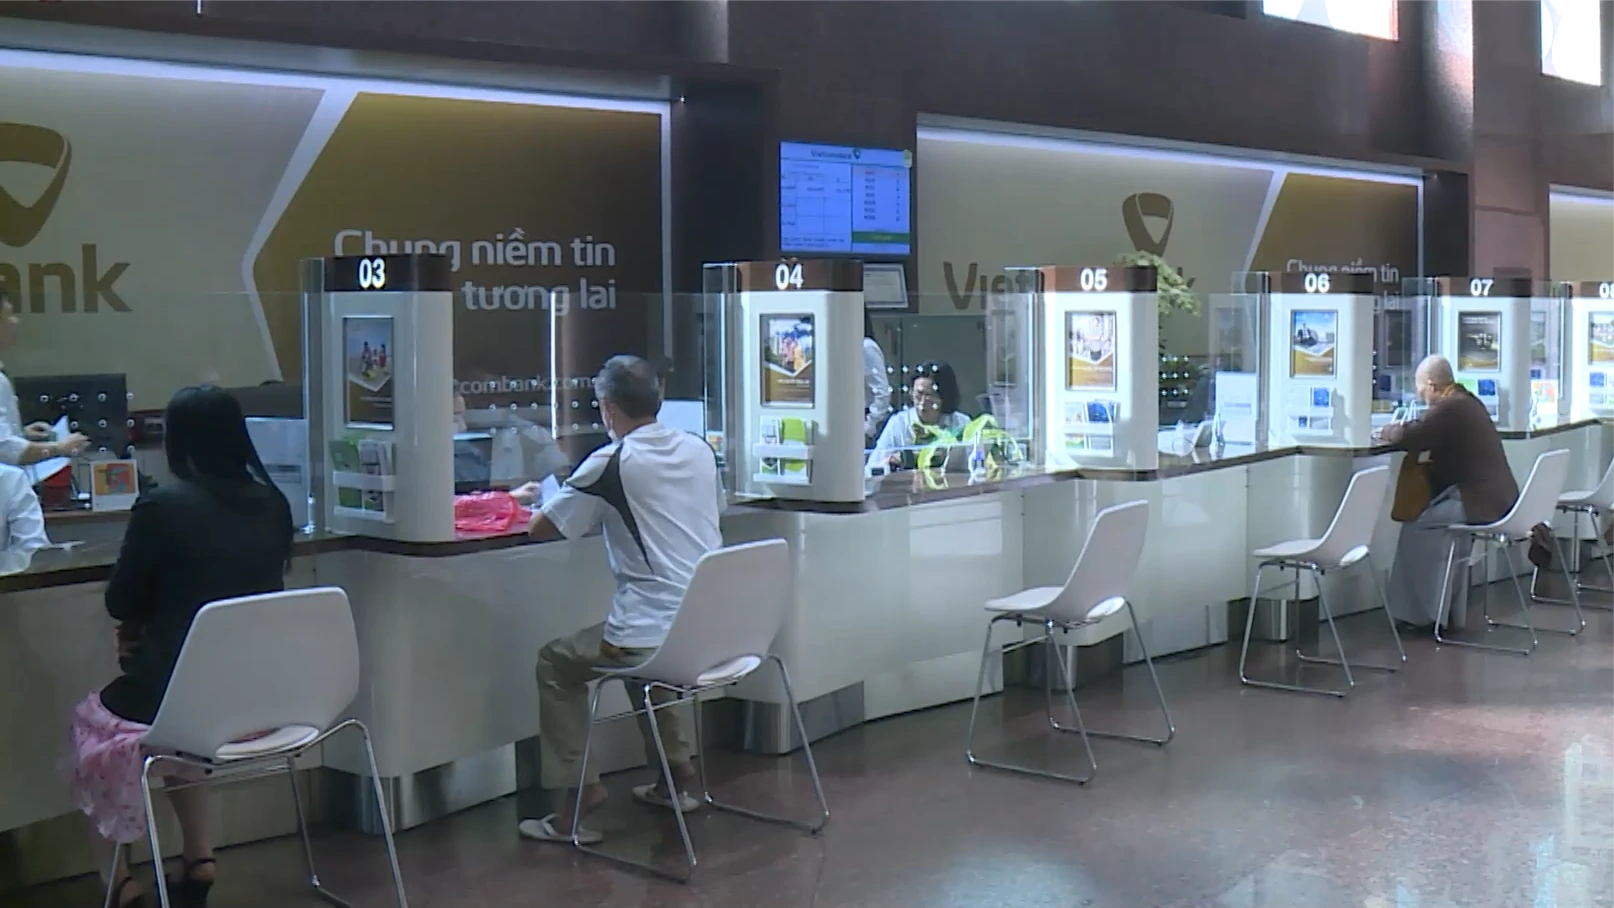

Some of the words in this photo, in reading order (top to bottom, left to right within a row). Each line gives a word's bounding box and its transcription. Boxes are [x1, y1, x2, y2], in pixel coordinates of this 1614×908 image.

[472, 227, 562, 266] niềm
[570, 235, 615, 266] tin
[358, 258, 386, 289] 03
[775, 263, 804, 290] 04
[1080, 267, 1108, 291] 05
[1304, 272, 1331, 294] 06
[1380, 263, 1399, 283] tin
[462, 280, 569, 316] tương
[580, 278, 616, 310] lai
[1470, 278, 1494, 296] 07
